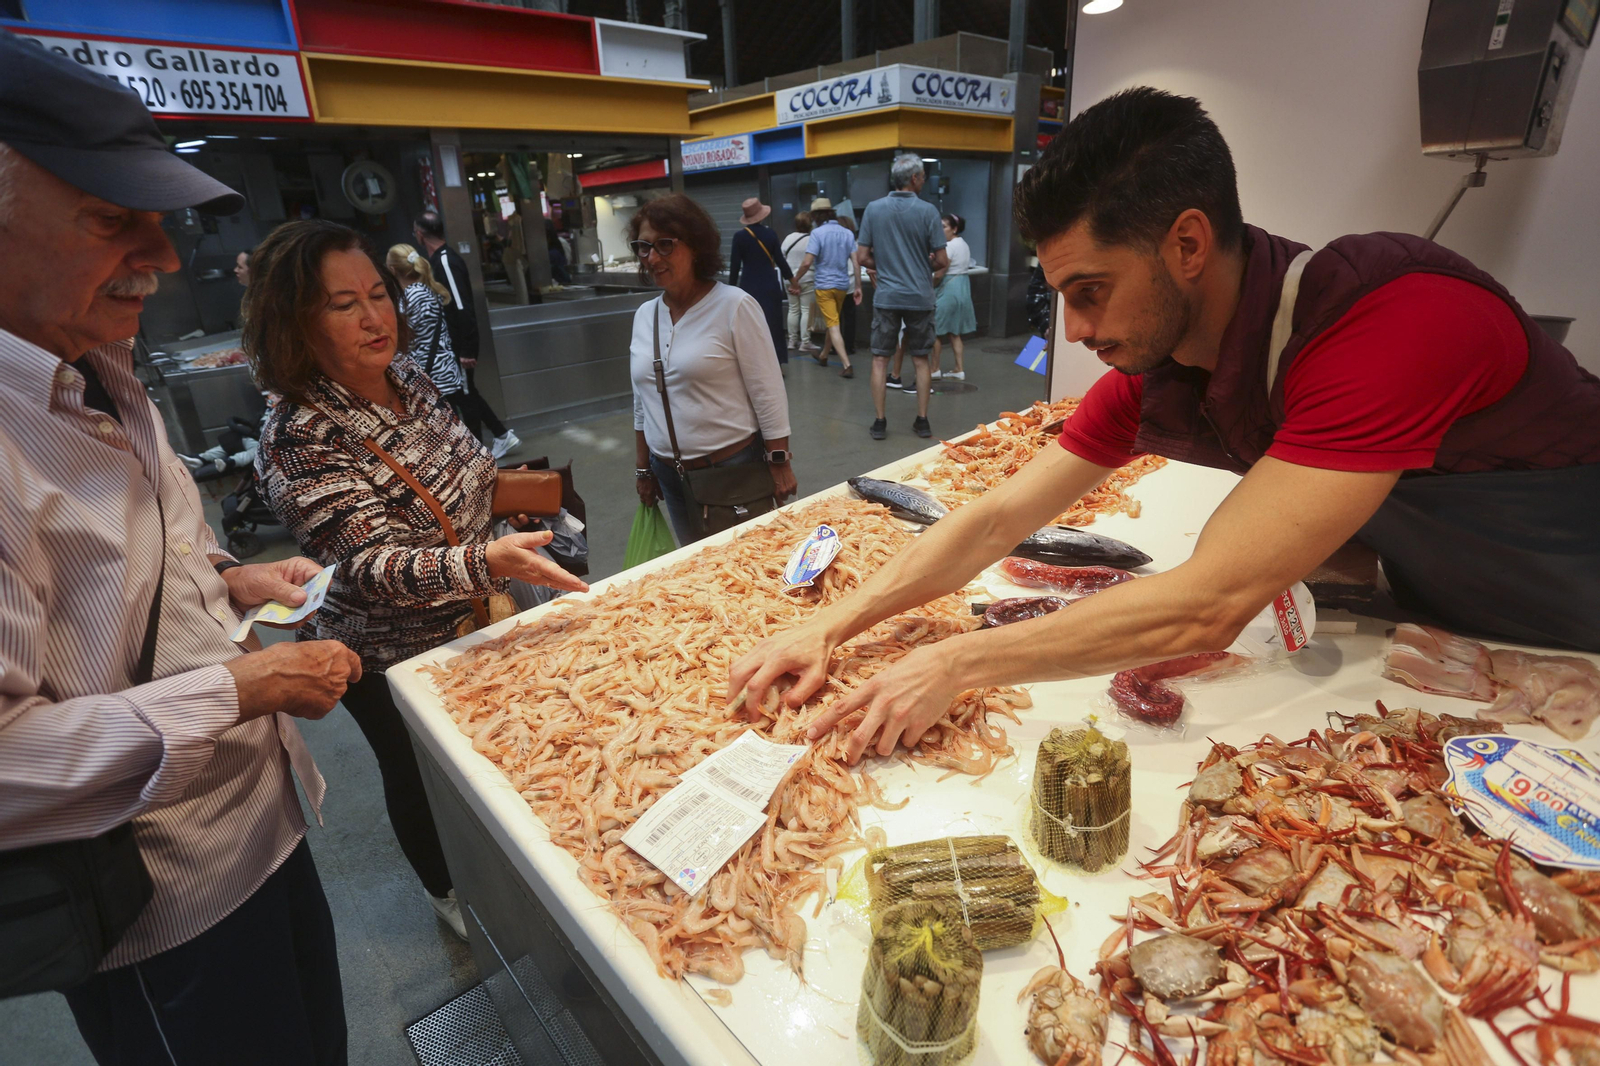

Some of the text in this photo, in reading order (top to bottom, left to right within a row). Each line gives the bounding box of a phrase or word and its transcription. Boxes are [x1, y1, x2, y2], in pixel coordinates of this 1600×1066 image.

[145, 48, 280, 78] Gallardo
[180, 78, 215, 110] 695
[216, 81, 253, 111] 354
[253, 83, 288, 113] 704
[789, 74, 872, 108] COCORA
[912, 72, 992, 107] COCORA
[706, 147, 737, 163] ROSADO
